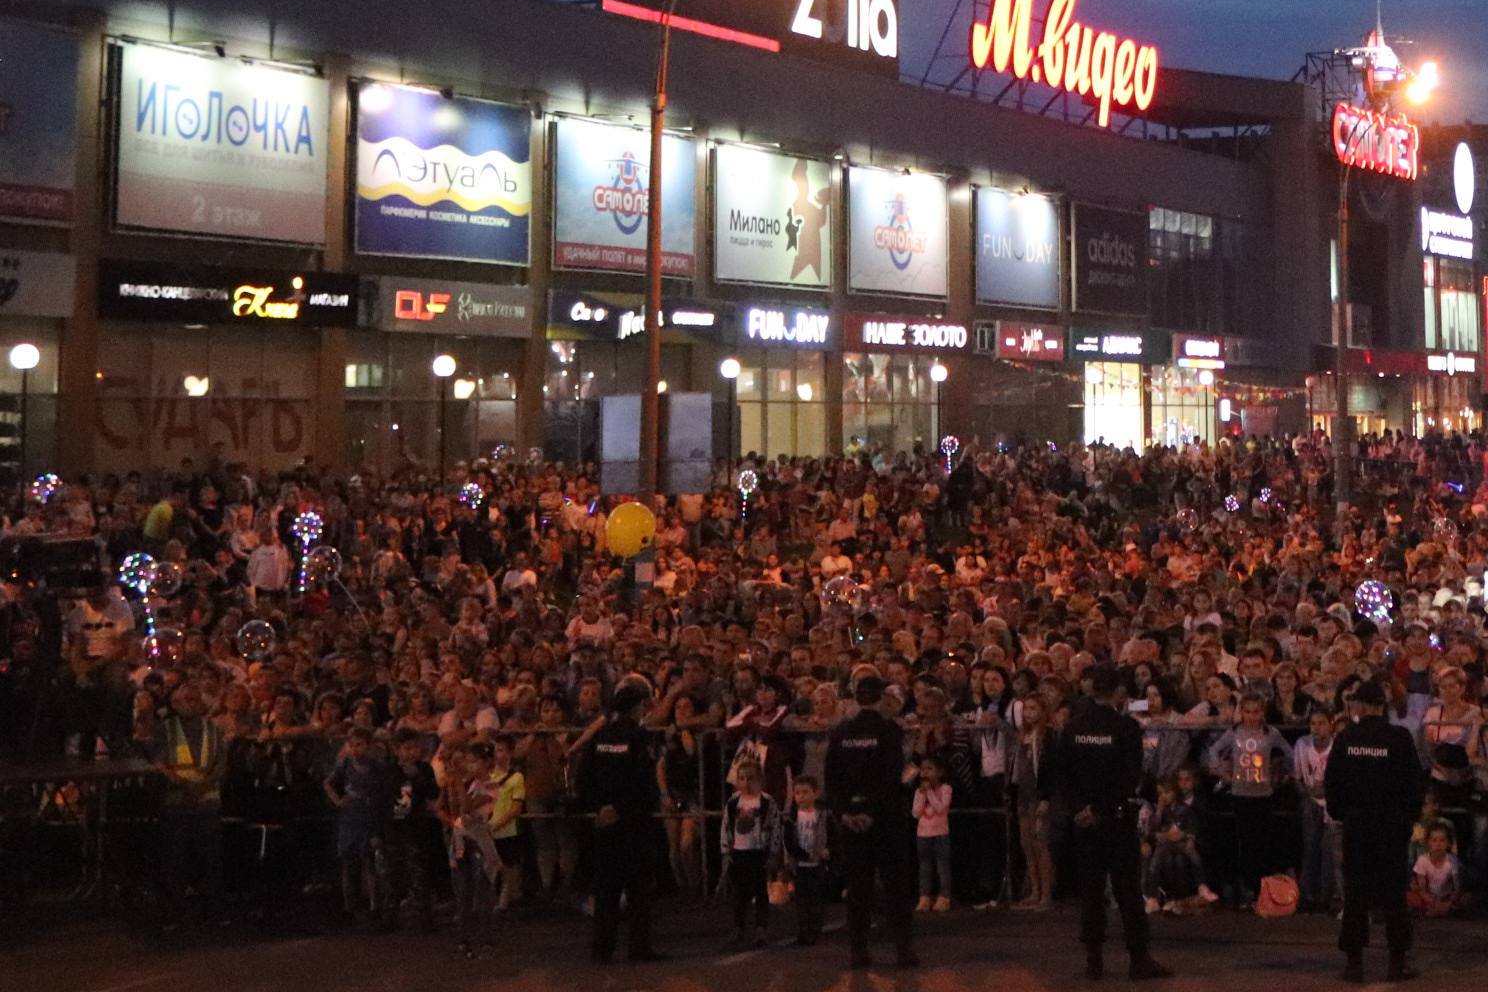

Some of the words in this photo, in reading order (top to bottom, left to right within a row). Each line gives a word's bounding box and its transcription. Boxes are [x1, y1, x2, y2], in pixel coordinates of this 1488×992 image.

[136, 79, 314, 157] ИГОЛОЧКА
[192, 195, 206, 223] 2
[593, 186, 650, 216] САМОЛЁ
[729, 209, 781, 236] Милано
[983, 233, 1012, 259] FUN
[1025, 239, 1053, 264] DAY
[1088, 233, 1136, 268] adidas
[310, 294, 349, 307] МАГАЗИН
[748, 308, 784, 341] FUN
[796, 312, 829, 343] DAY
[863, 322, 906, 345] НАШЕ
[908, 324, 967, 347] ЗОЛОТО
[842, 738, 878, 747] ПОЛИЦИЯ
[1075, 735, 1112, 745] ПОЛИЦИЯ
[1347, 746, 1388, 757] ПОЛИЦИЯ
